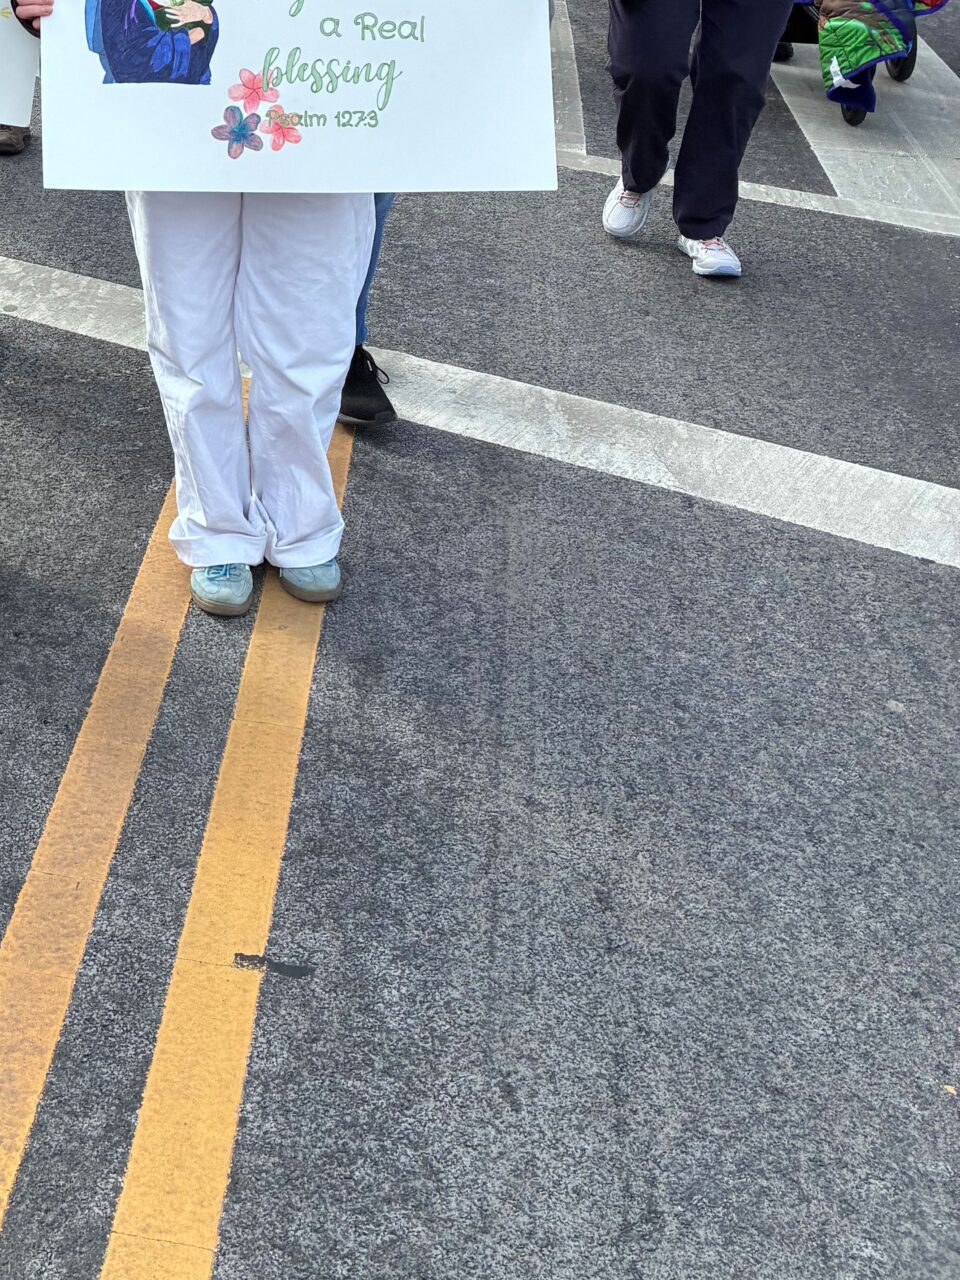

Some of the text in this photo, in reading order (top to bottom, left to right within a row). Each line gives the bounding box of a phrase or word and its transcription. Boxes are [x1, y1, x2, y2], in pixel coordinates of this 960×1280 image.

[320, 12, 425, 43] a Real
[262, 47, 403, 111] blessing
[265, 110, 328, 128] Psalm
